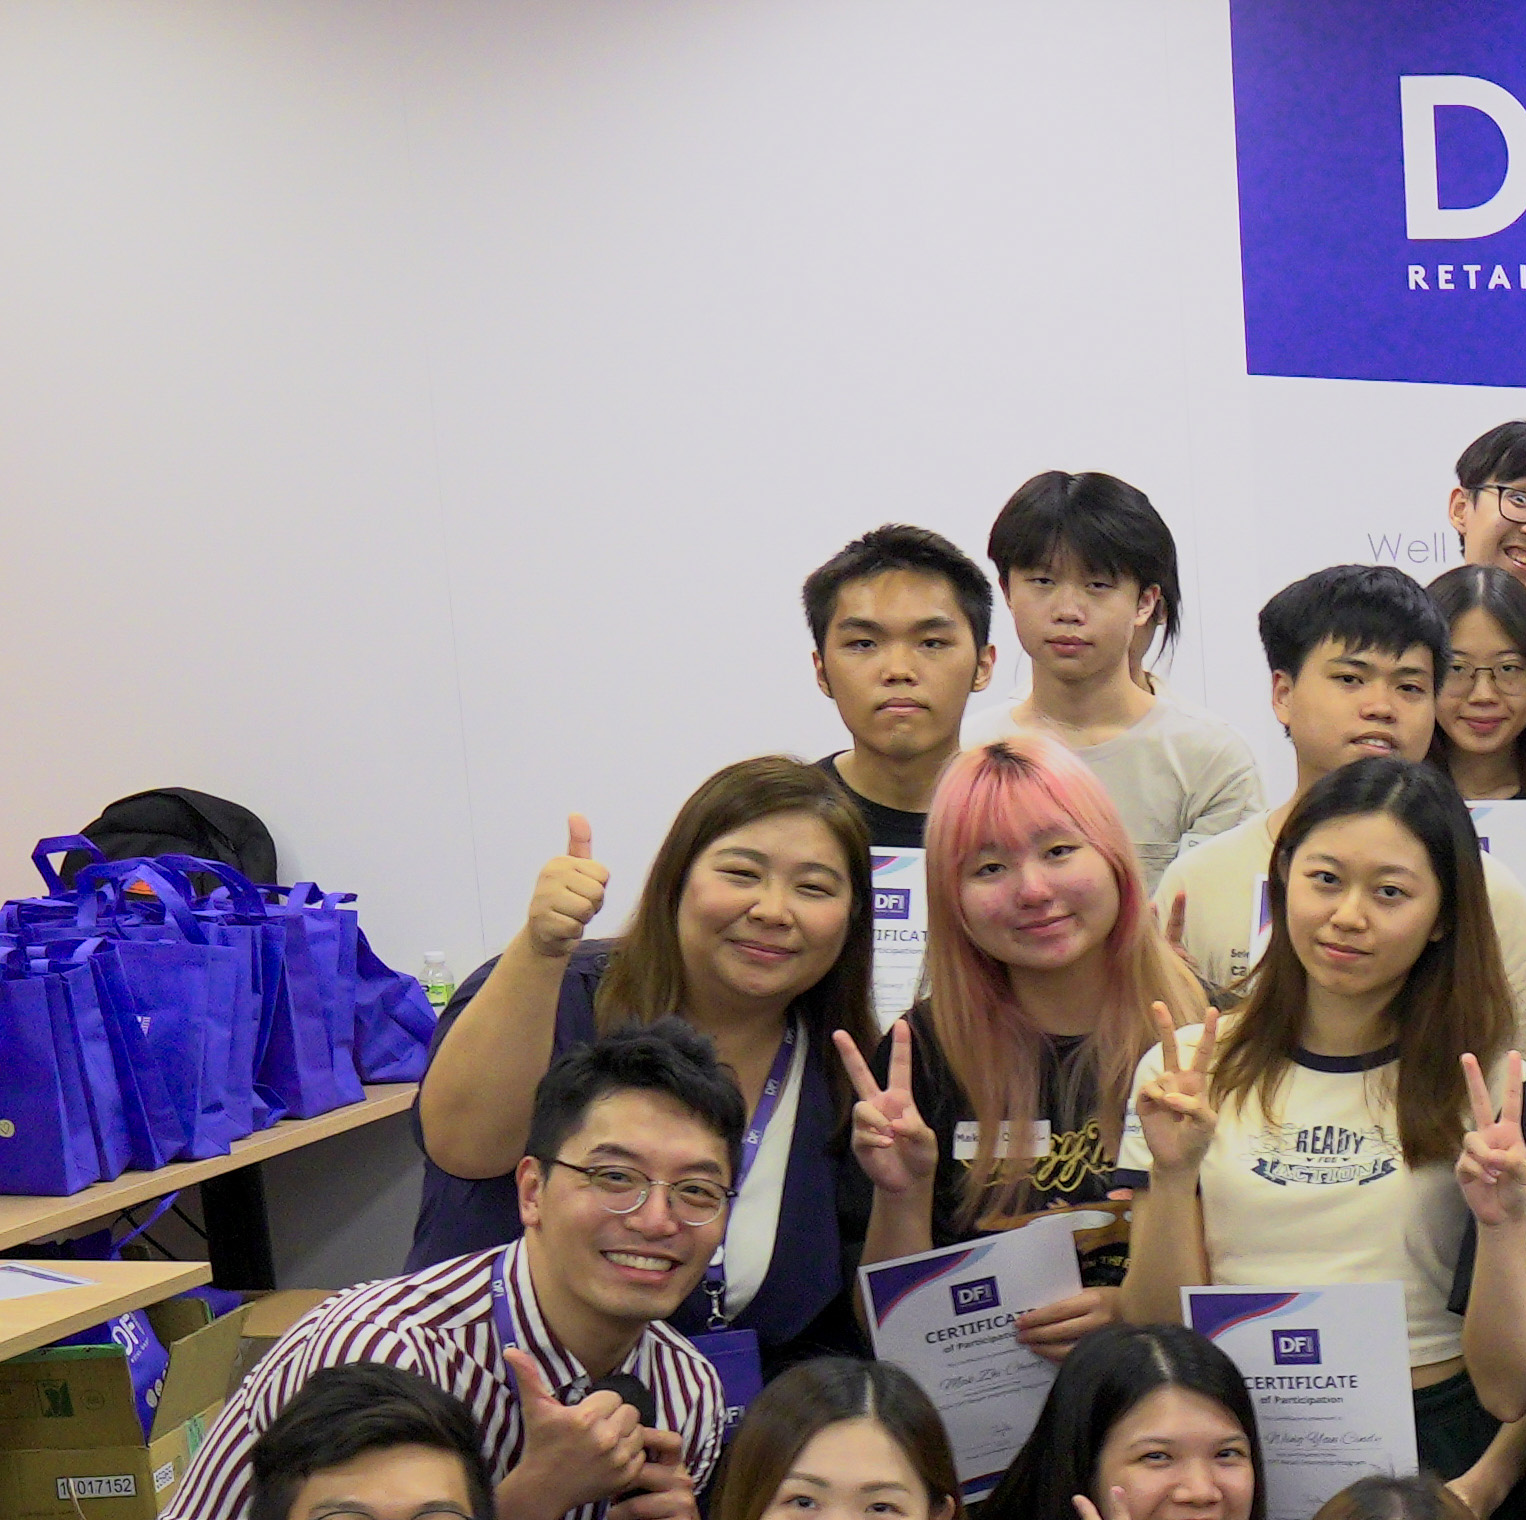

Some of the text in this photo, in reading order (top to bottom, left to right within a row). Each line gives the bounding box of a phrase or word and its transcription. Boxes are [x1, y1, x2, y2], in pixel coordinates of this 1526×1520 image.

[1367, 532, 1447, 563] Well
[874, 894, 905, 910] DFI
[1296, 1126, 1364, 1154] READY
[958, 1284, 993, 1305] DFI
[1280, 1337, 1313, 1353] DFI
[1244, 1375, 1359, 1389] CERTIFICATE
[1275, 1396, 1344, 1405] Participation
